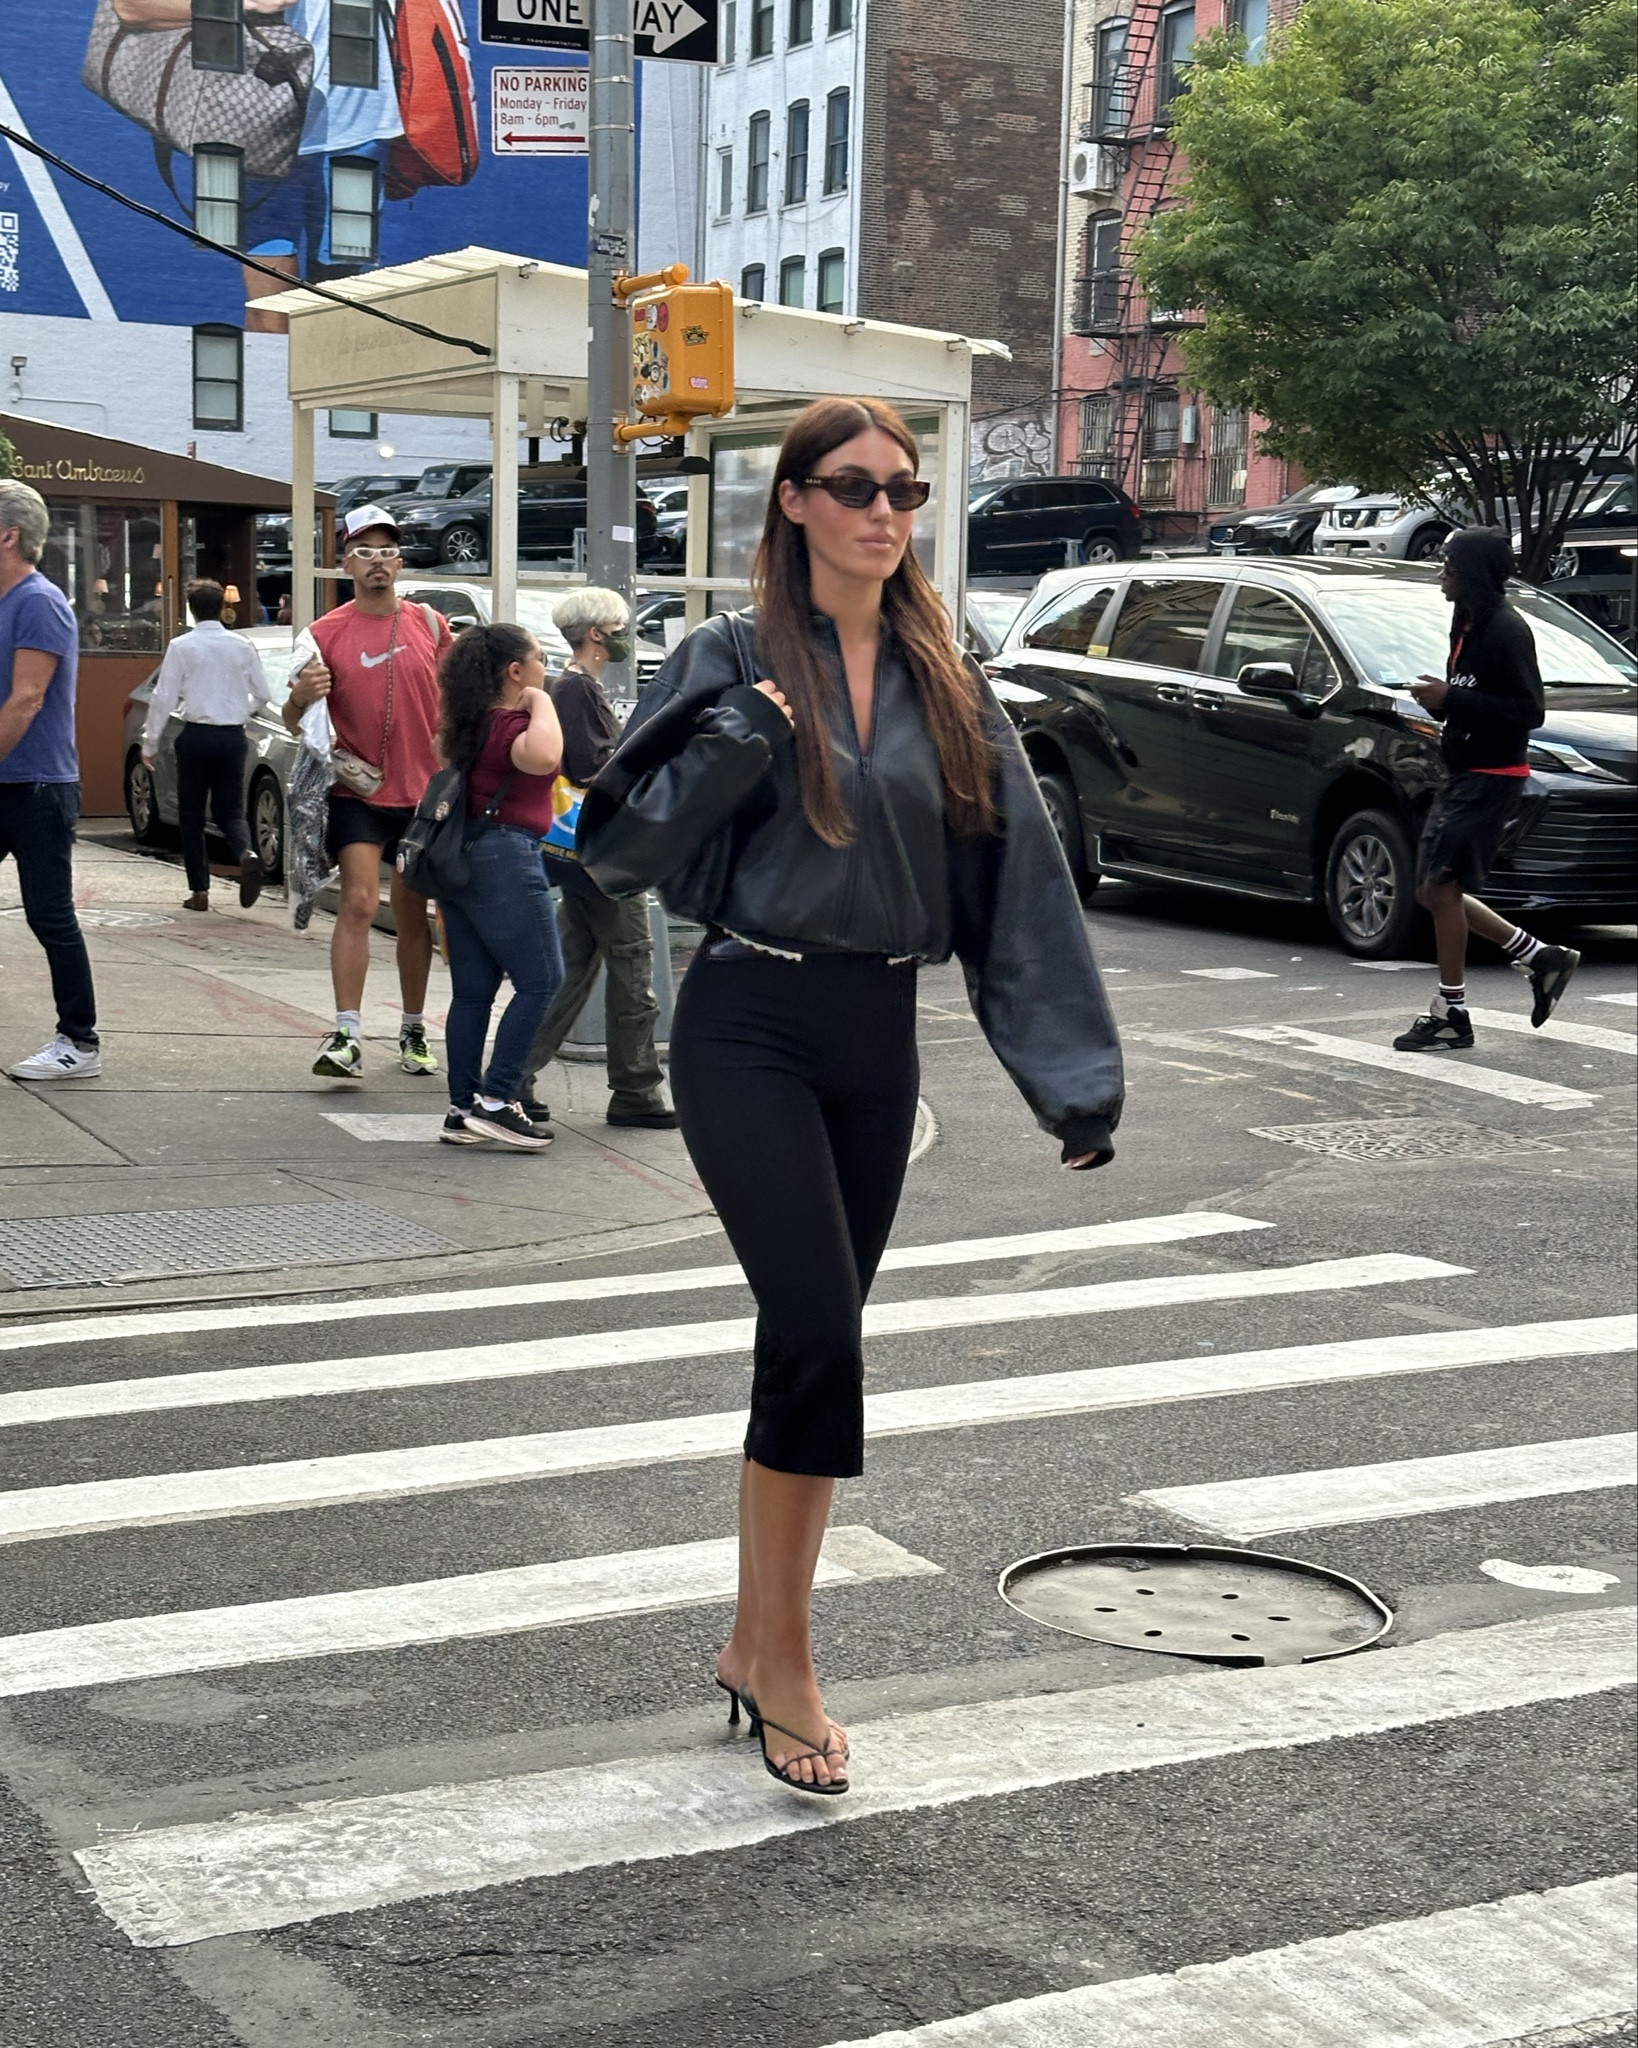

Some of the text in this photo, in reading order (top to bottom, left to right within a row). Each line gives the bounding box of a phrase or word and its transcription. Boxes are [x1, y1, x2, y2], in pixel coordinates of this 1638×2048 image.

[517, 0, 684, 34] ONE AY
[526, 37, 582, 47] TRANSPORTATION
[500, 76, 588, 92] NO PARKING
[500, 97, 542, 111] Monday
[554, 97, 588, 112] Friday
[500, 113, 525, 126] 8am
[535, 113, 560, 129] 6pm
[9, 455, 53, 479] Sant
